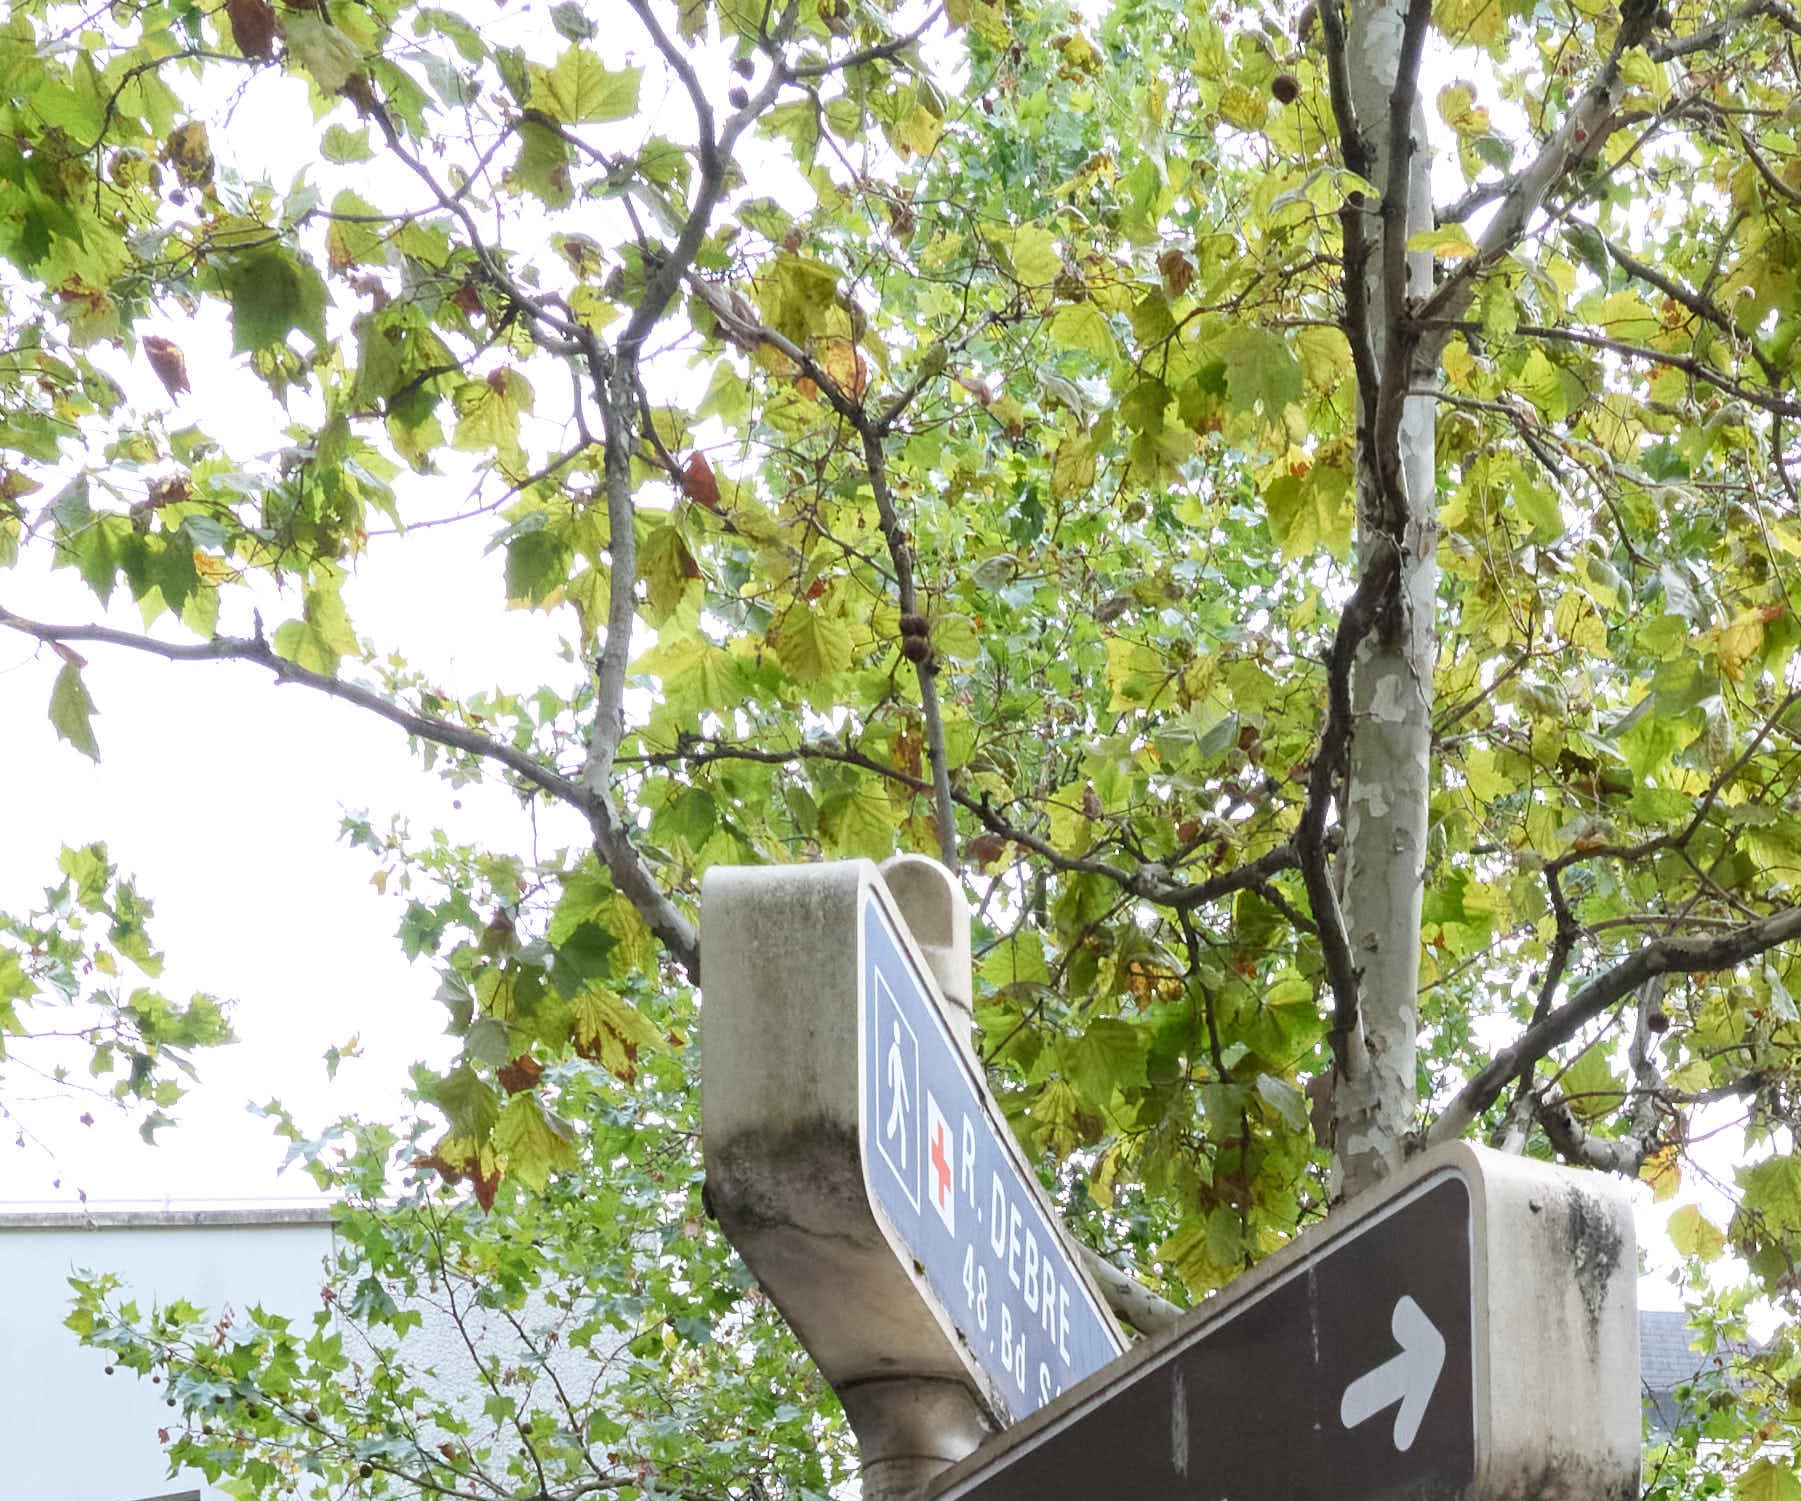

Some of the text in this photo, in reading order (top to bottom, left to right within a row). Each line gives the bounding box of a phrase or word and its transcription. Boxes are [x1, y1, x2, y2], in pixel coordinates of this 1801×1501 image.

[961, 1111, 1072, 1368] R. DEBRE
[1000, 1301, 1026, 1395] Bd
